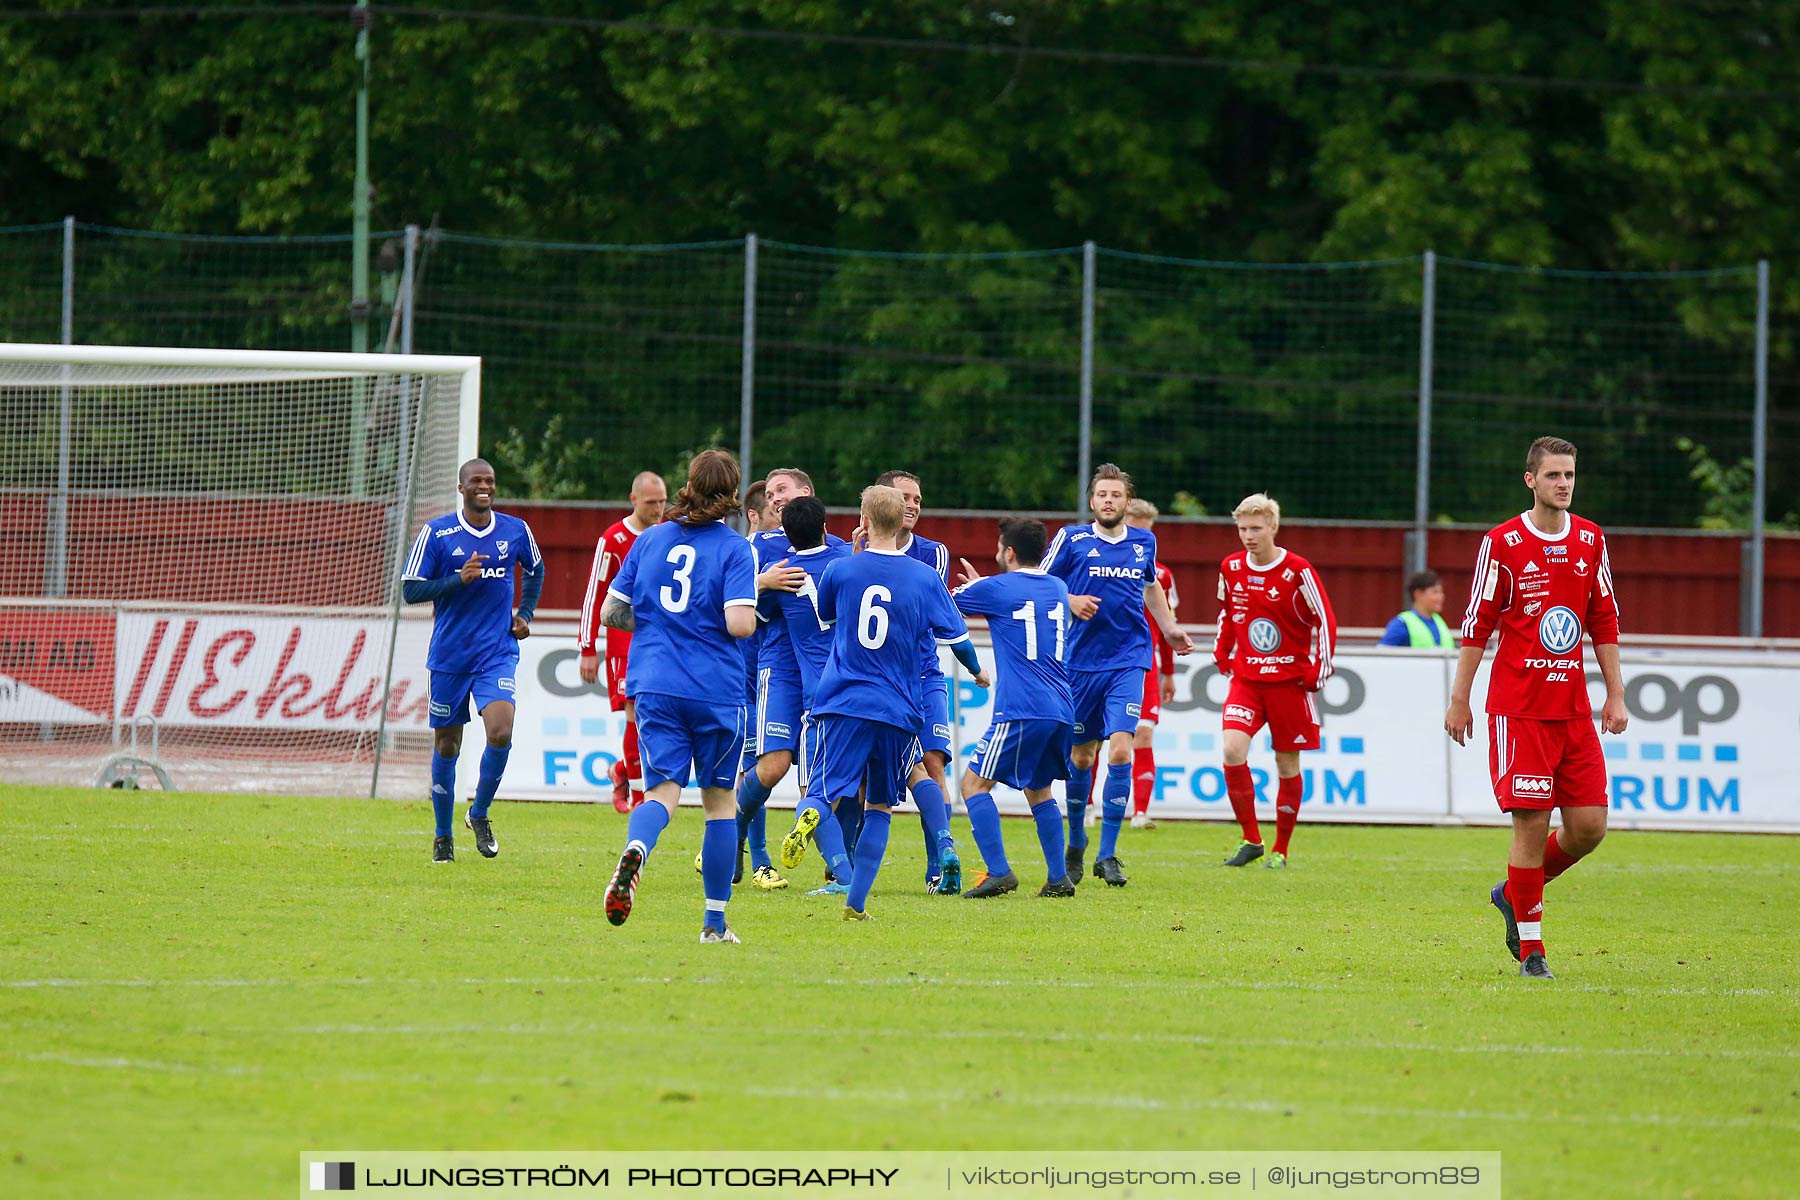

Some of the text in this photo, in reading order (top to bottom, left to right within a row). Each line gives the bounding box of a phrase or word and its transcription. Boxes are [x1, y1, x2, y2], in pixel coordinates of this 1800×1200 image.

[660, 544, 696, 613] 3
[857, 584, 892, 650] 6
[1012, 600, 1065, 661] 11
[1259, 665, 1279, 674] BIL
[1524, 658, 1580, 669] TOVEK
[1546, 672, 1569, 682] BIL
[1611, 775, 1741, 813] RUM
